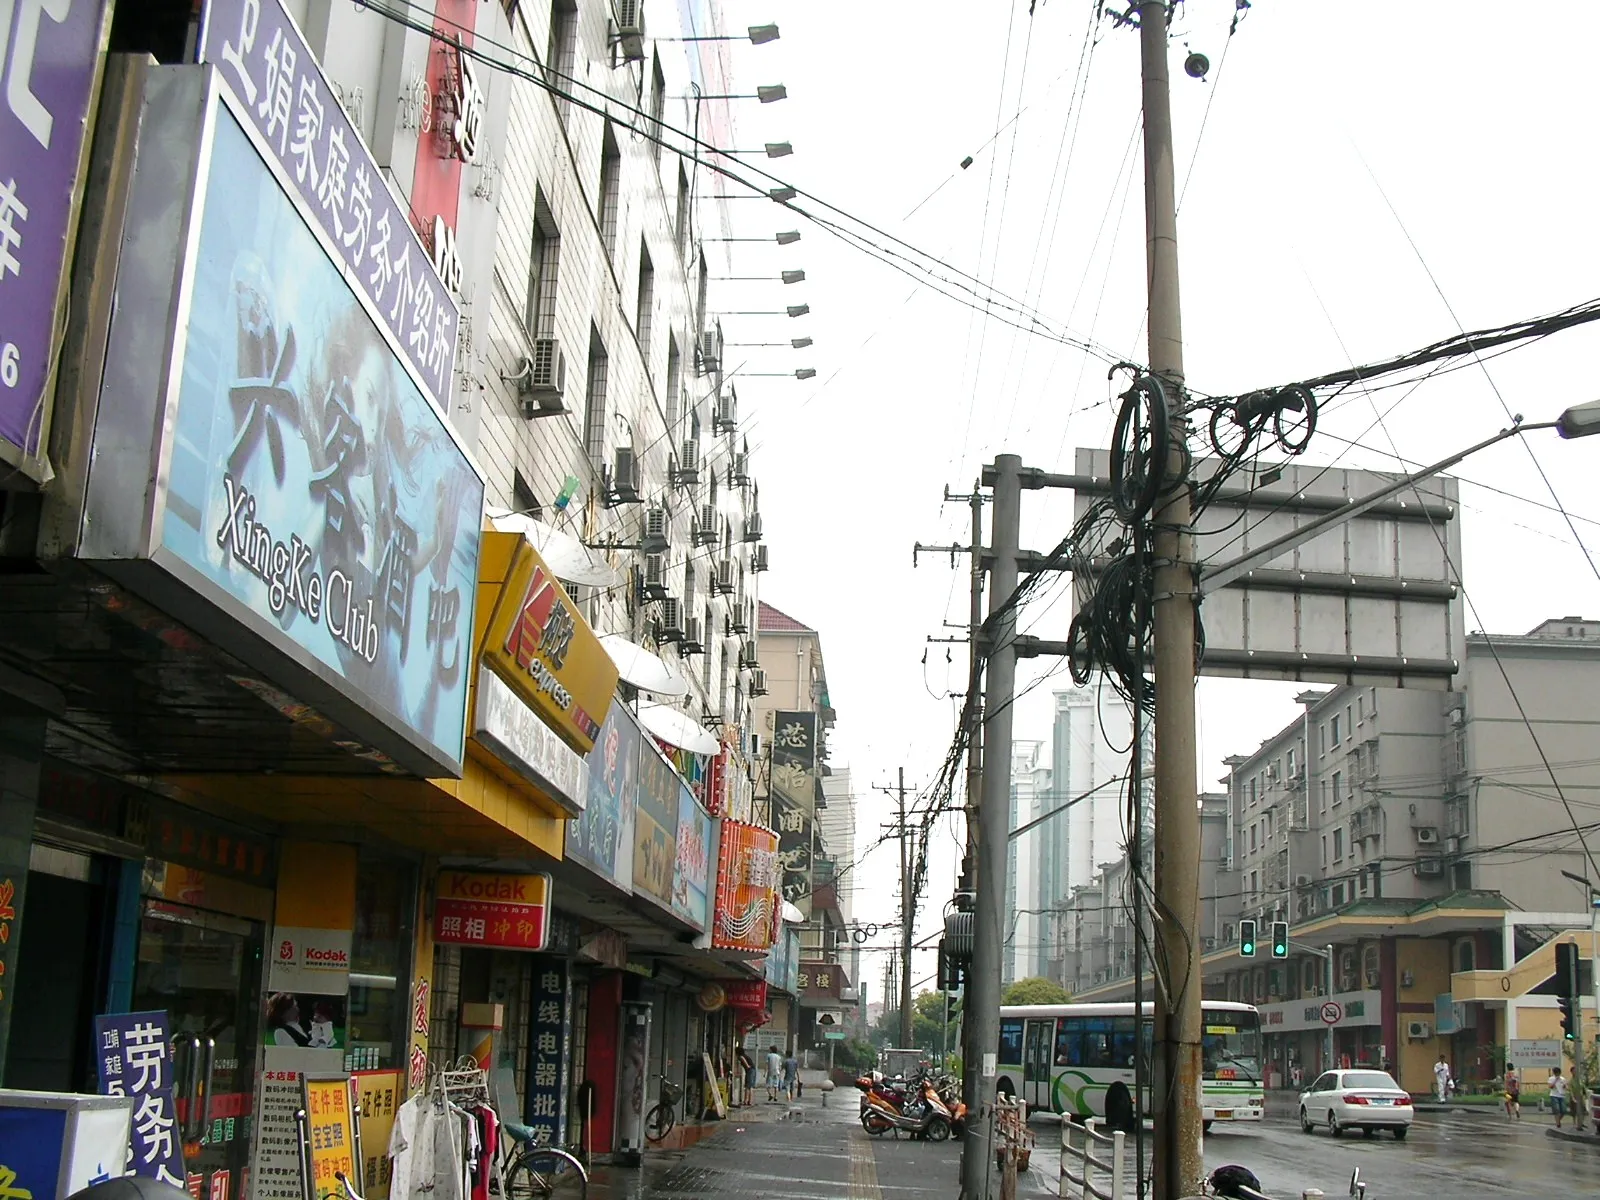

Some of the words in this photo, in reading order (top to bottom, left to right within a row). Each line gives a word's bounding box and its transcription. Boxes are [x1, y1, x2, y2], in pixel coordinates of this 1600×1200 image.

[217, 477, 322, 618] XingKe
[325, 569, 378, 662] Club
[529, 657, 572, 710] express
[451, 873, 527, 900] Kodak
[306, 947, 347, 962] Kodak
[310, 1089, 344, 1114] 证件照
[363, 1089, 393, 1117] 证件照
[313, 1122, 344, 1149] 宝宝照
